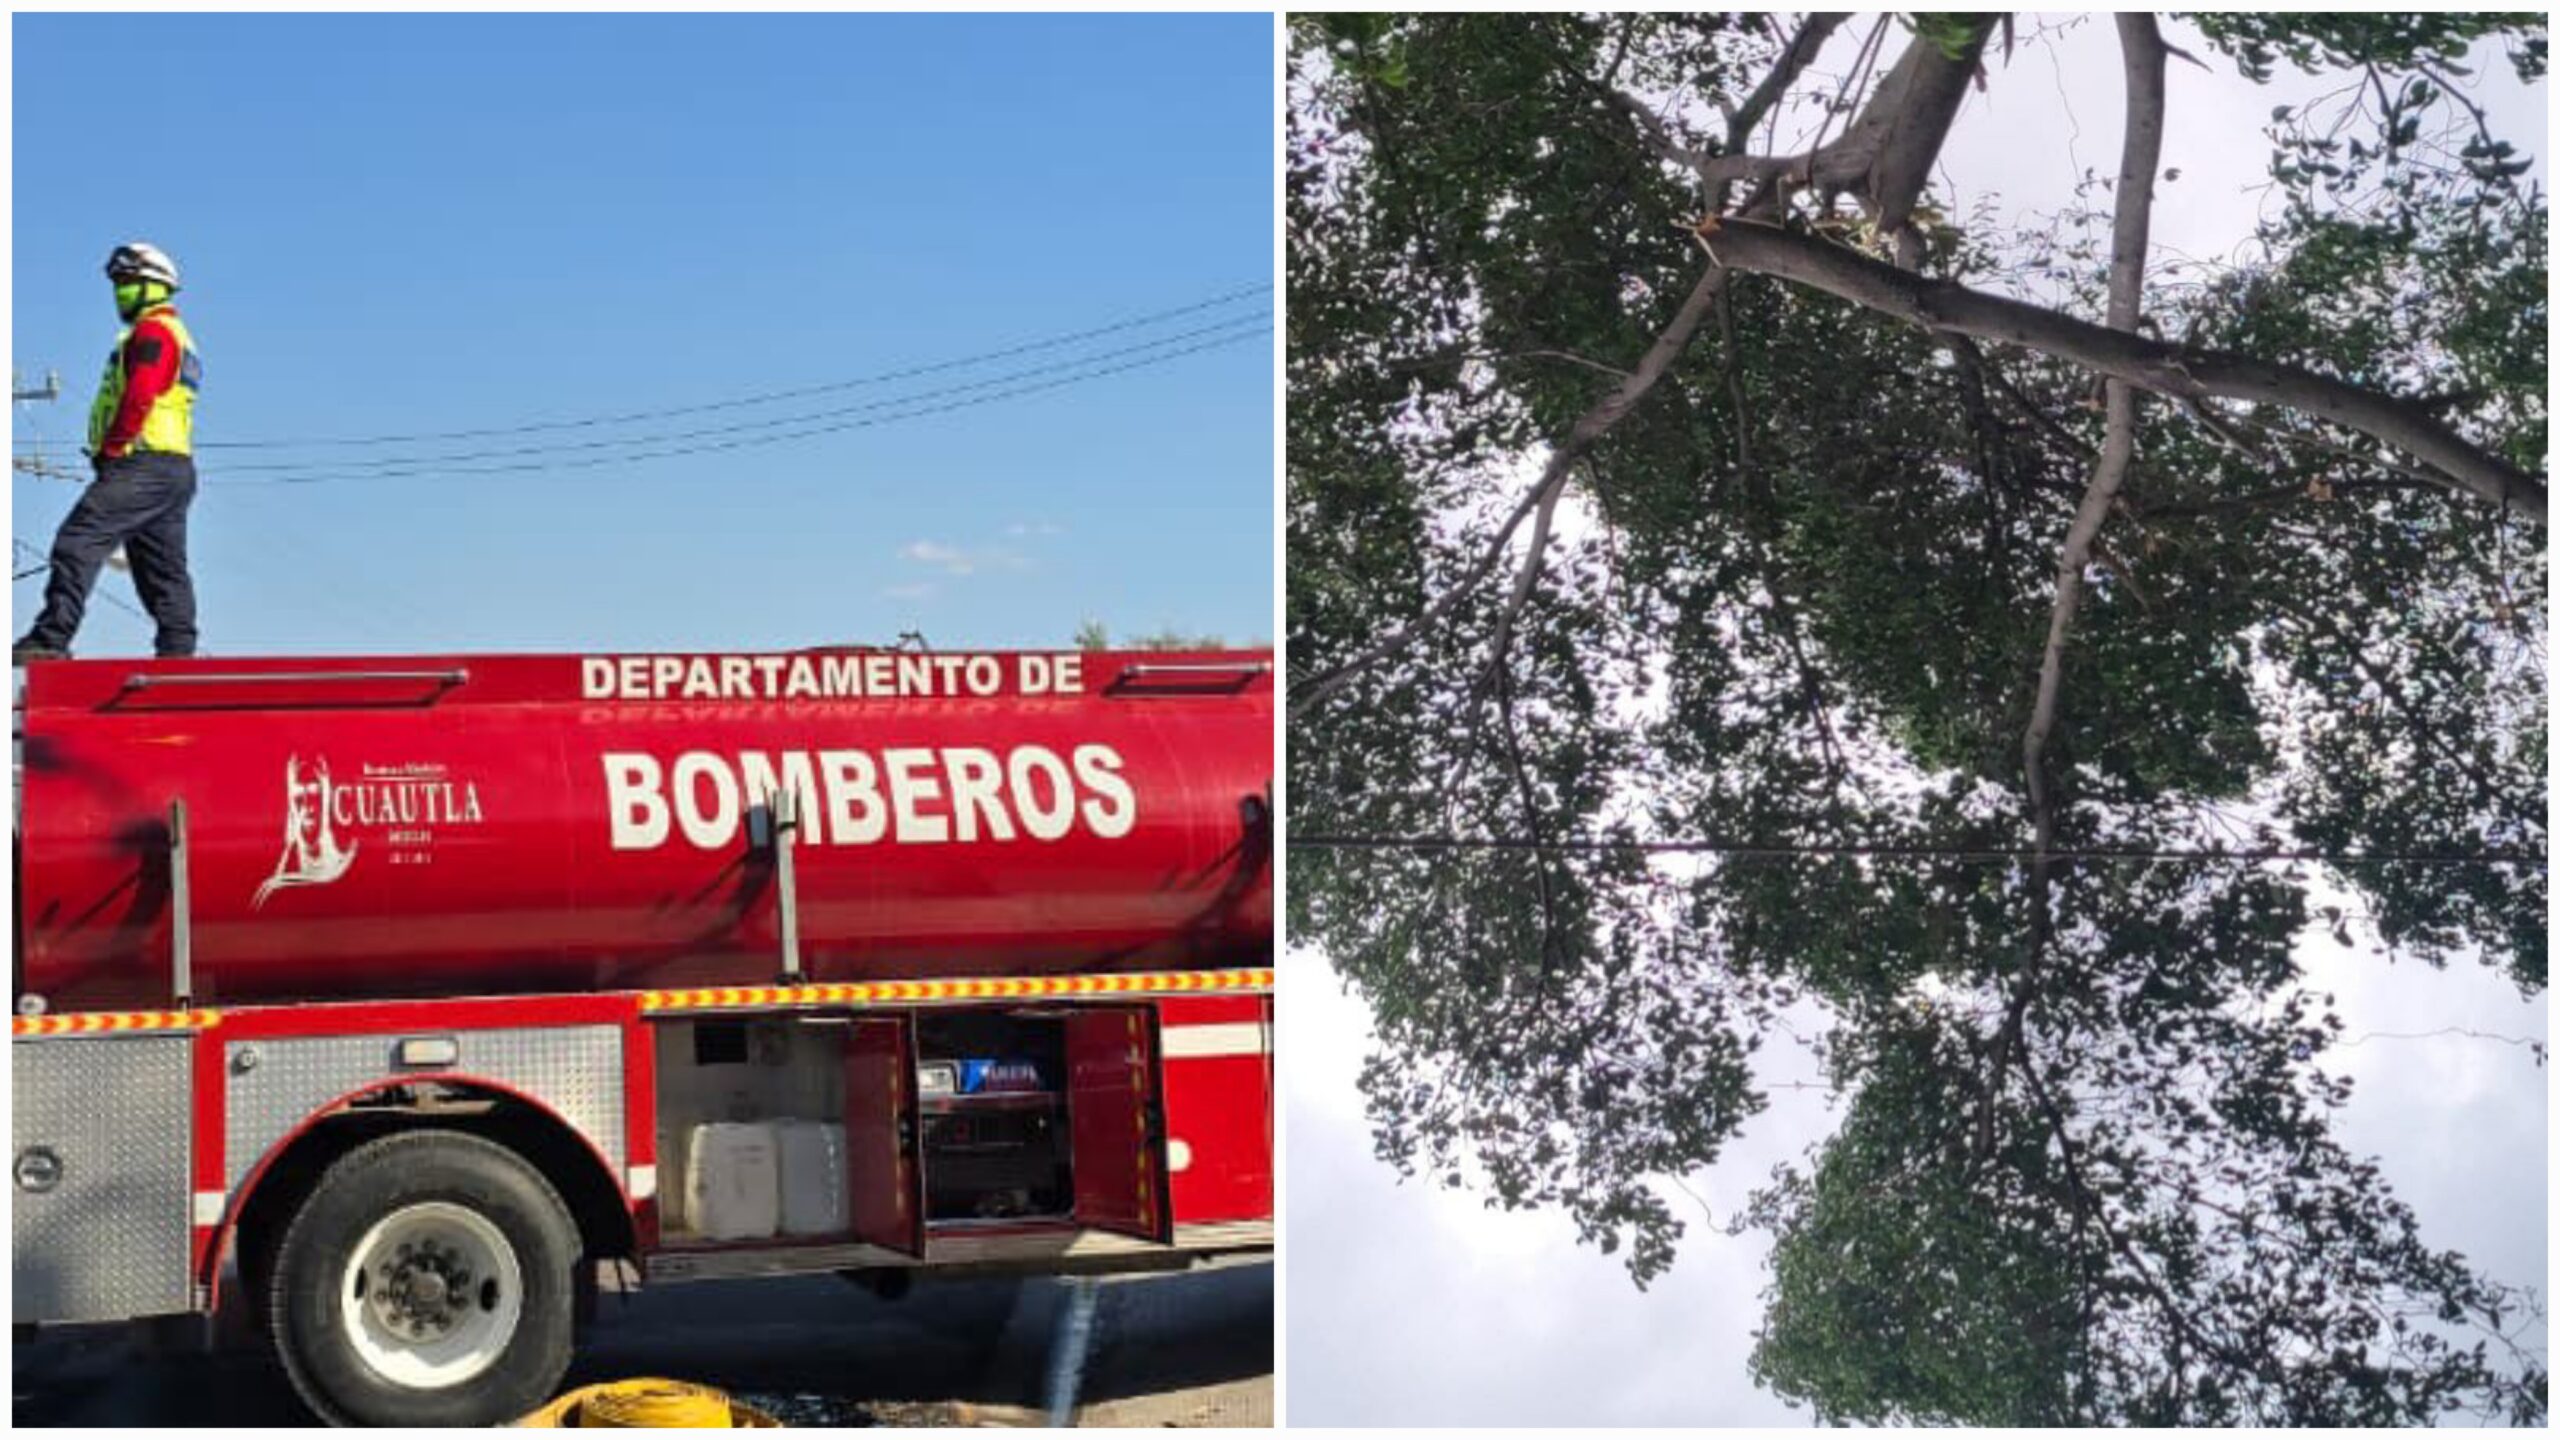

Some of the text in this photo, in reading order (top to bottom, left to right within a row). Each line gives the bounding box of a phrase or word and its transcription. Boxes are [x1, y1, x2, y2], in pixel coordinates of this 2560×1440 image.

[582, 655, 1085, 699] DEPARTAMENTO DE
[334, 781, 482, 825] CUAUTLA
[602, 744, 1136, 849] BOMBEROS
